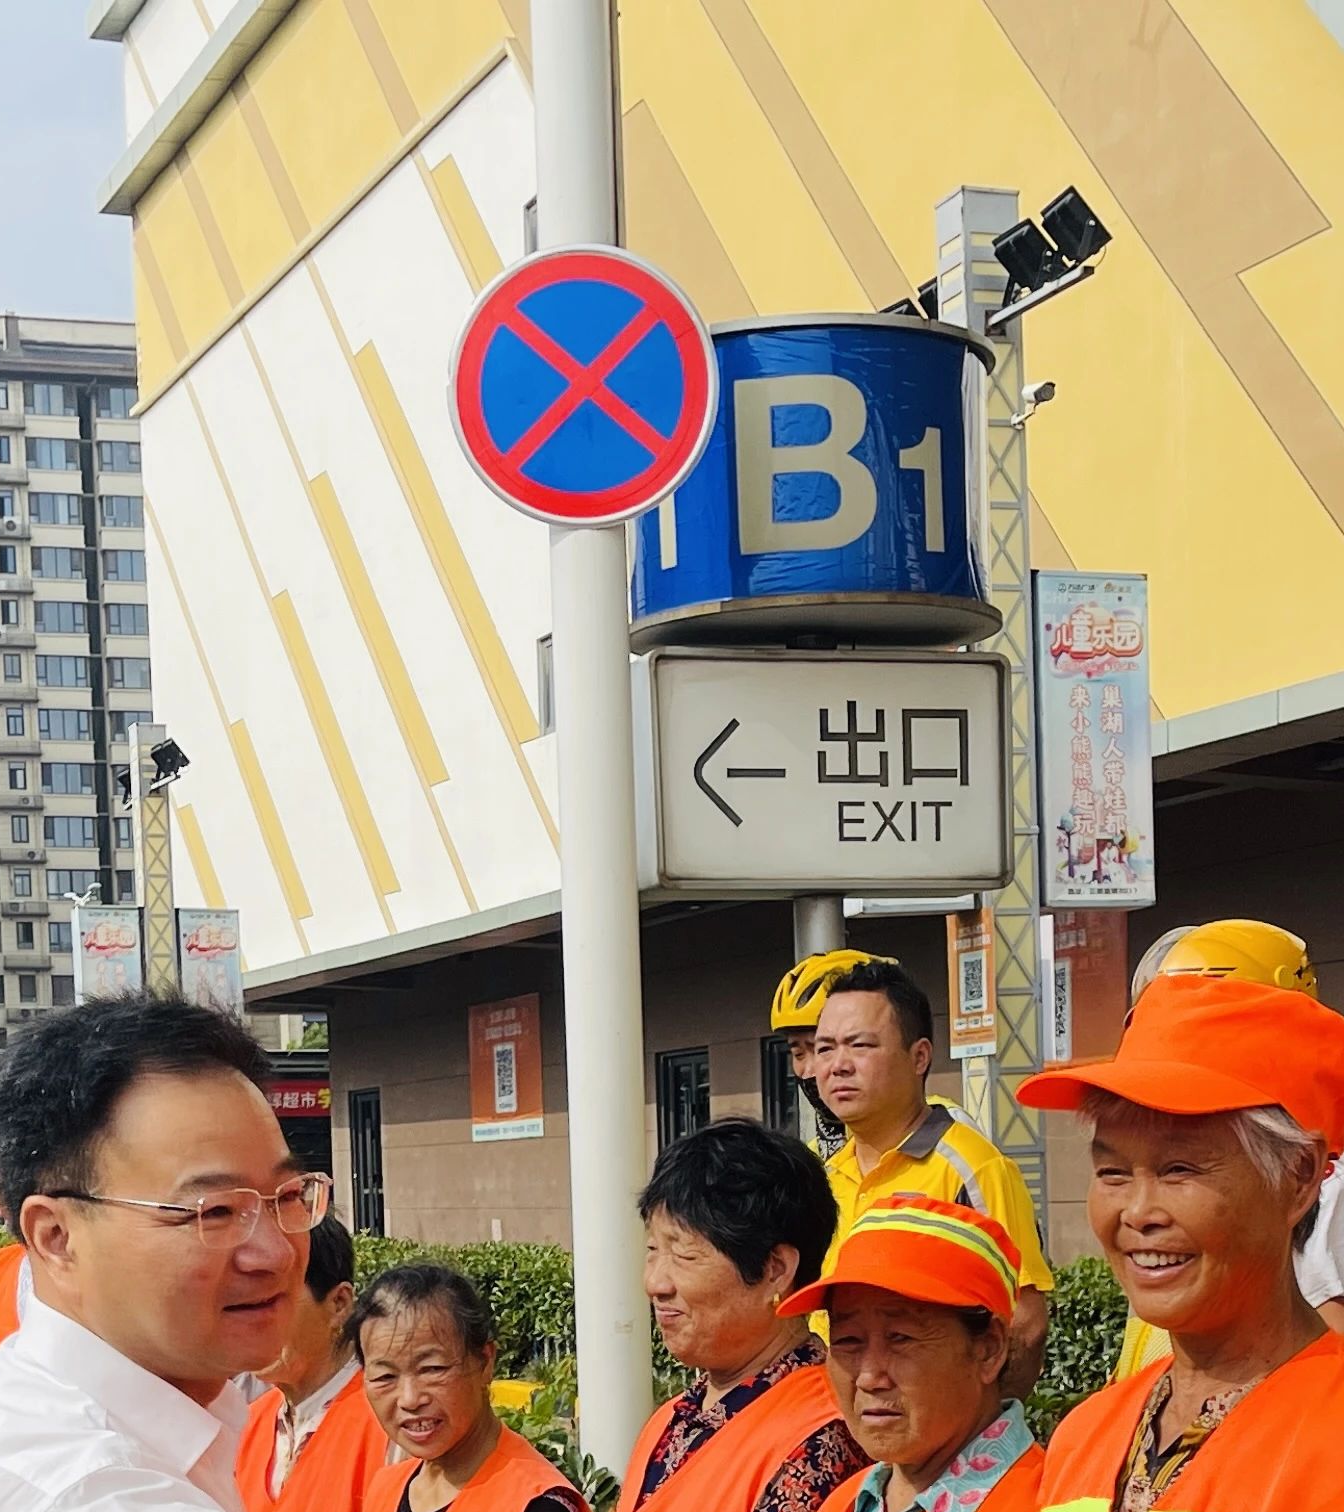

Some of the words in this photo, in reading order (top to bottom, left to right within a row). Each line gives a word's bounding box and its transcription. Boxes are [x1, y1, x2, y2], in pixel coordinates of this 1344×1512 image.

[733, 373, 946, 556] B1
[1051, 606, 1143, 656] 儿童乐园
[817, 699, 970, 788] 出口
[837, 800, 953, 842] EXIT
